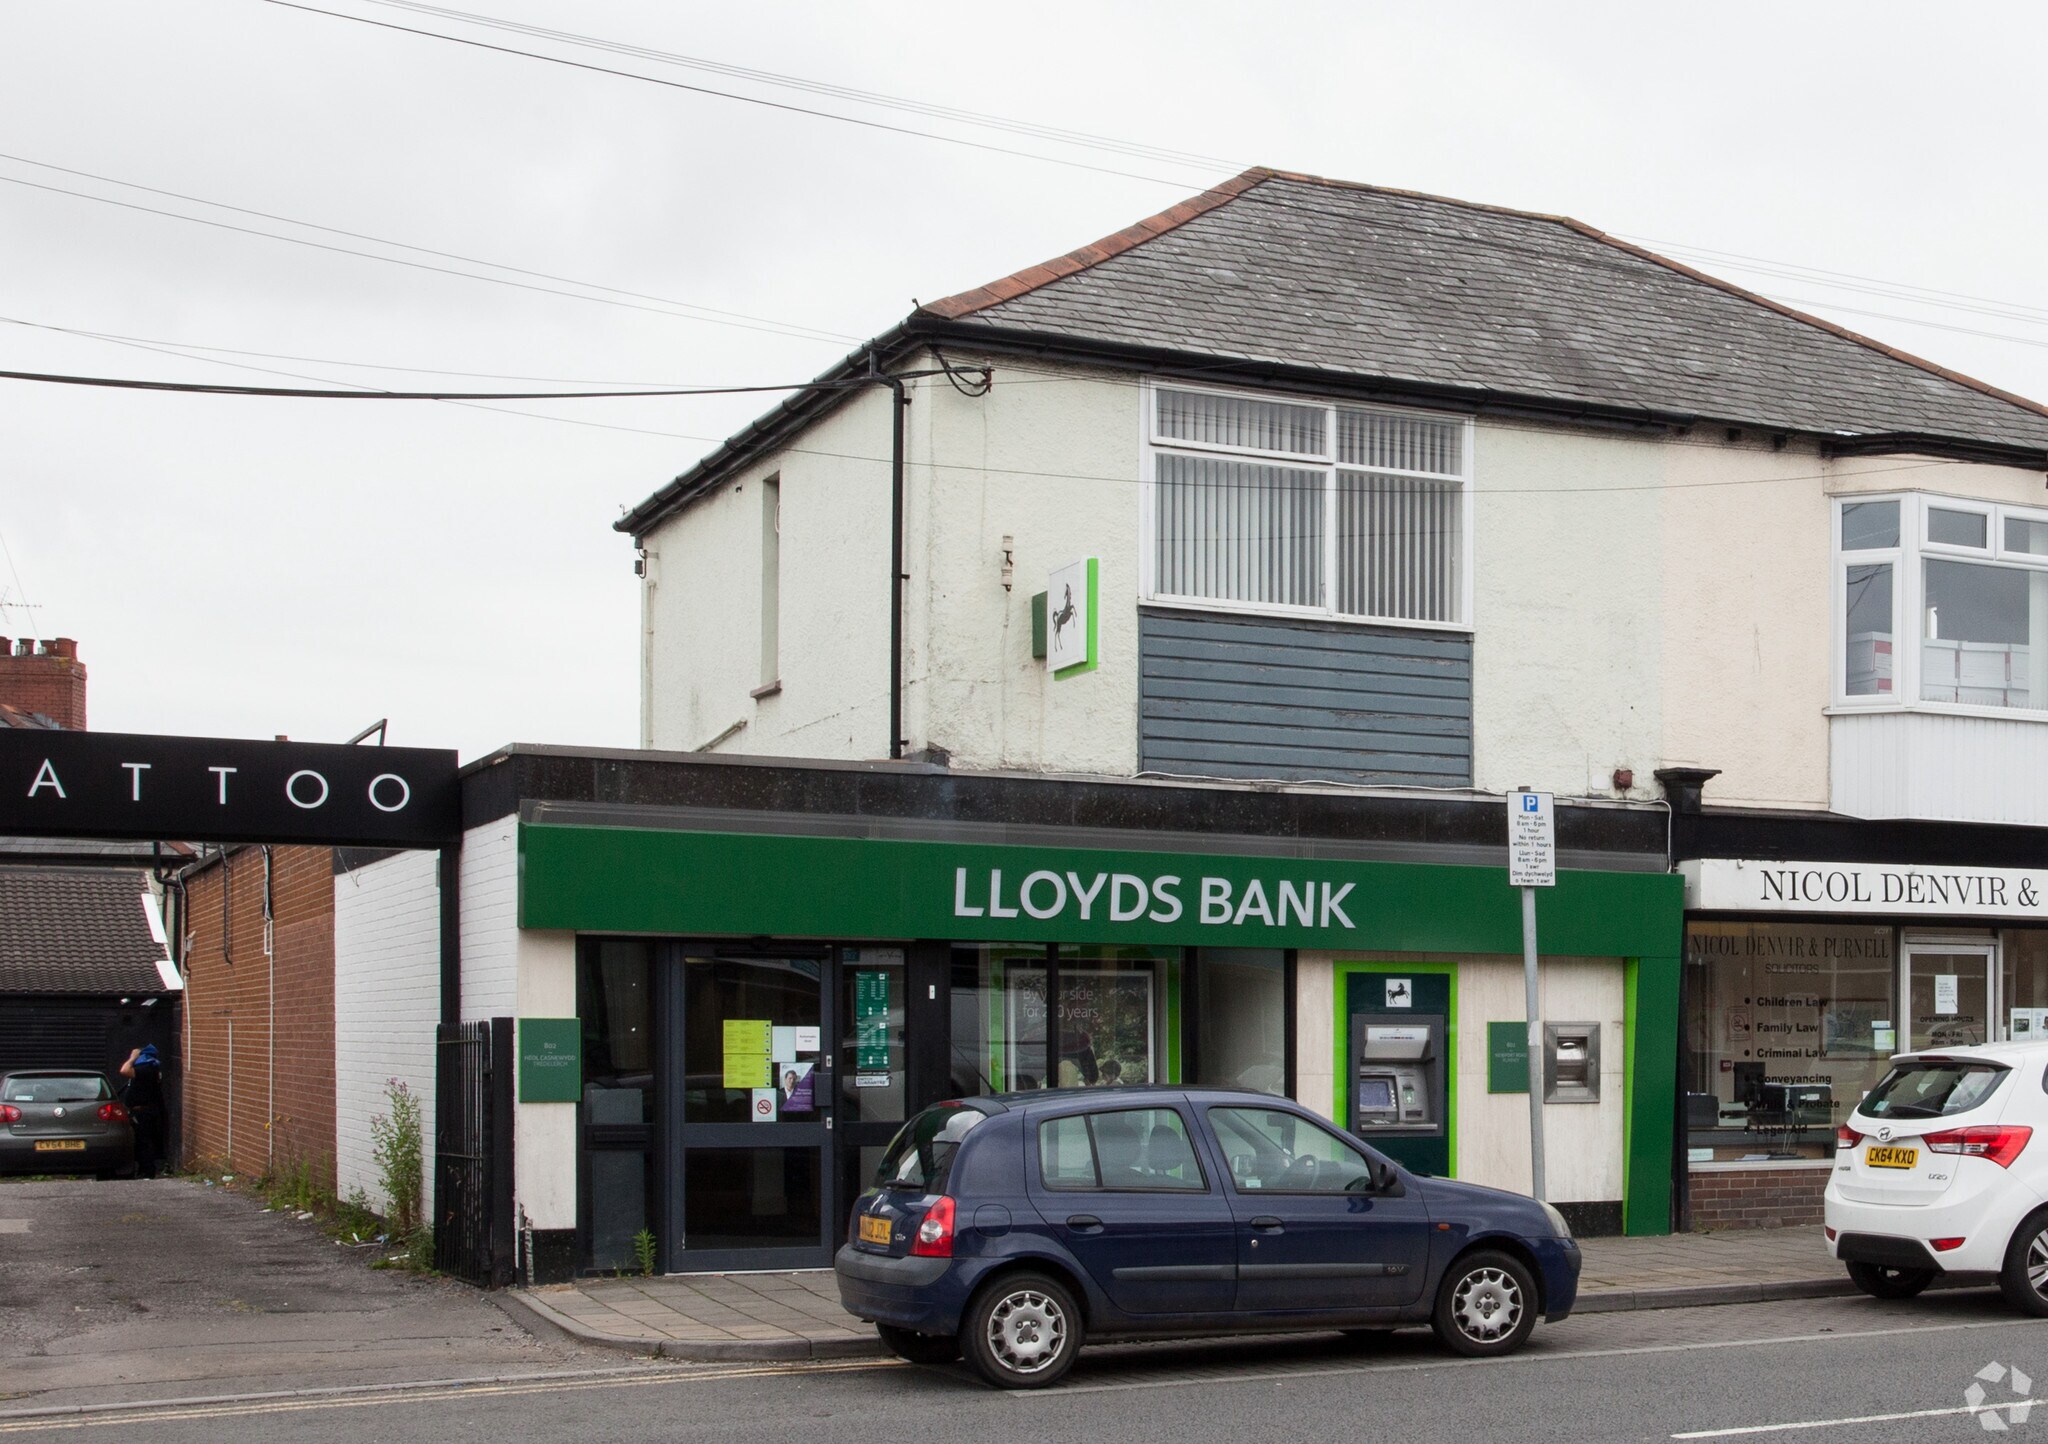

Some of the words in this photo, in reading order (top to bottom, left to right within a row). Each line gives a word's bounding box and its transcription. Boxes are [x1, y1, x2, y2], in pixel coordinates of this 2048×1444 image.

[1526, 797, 1536, 810] P
[1760, 870, 1872, 902] NICOL
[1881, 873, 2008, 906] DENVIR
[2018, 877, 2040, 907] &
[954, 867, 1183, 924] LLOYDS
[1200, 877, 1356, 929] BANK
[1692, 934, 1739, 956] NICOL
[1746, 936, 1808, 958] DENVIR
[1809, 938, 1818, 958] &
[1824, 938, 1889, 959] PURNELL
[1765, 963, 1819, 975] SOLICITORS
[1024, 987, 1036, 1003] By
[1040, 990, 1066, 1002] yr
[1757, 997, 1802, 1007] Children
[1806, 998, 1828, 1007] Law
[1023, 1004, 1039, 1018] for
[1042, 1004, 1064, 1018] 20
[1067, 1007, 1099, 1021] years
[1757, 1022, 1793, 1034] Family
[1796, 1023, 1818, 1032] Law
[1757, 1048, 1802, 1058] Criminal
[1806, 1049, 1828, 1058] Law
[1757, 1074, 1832, 1085] Conveyancing
[1798, 1099, 1840, 1109] Probate
[1757, 1125, 1786, 1136] Legal
[1790, 1125, 1807, 1134] Aid
[1869, 1148, 1892, 1162] CK64
